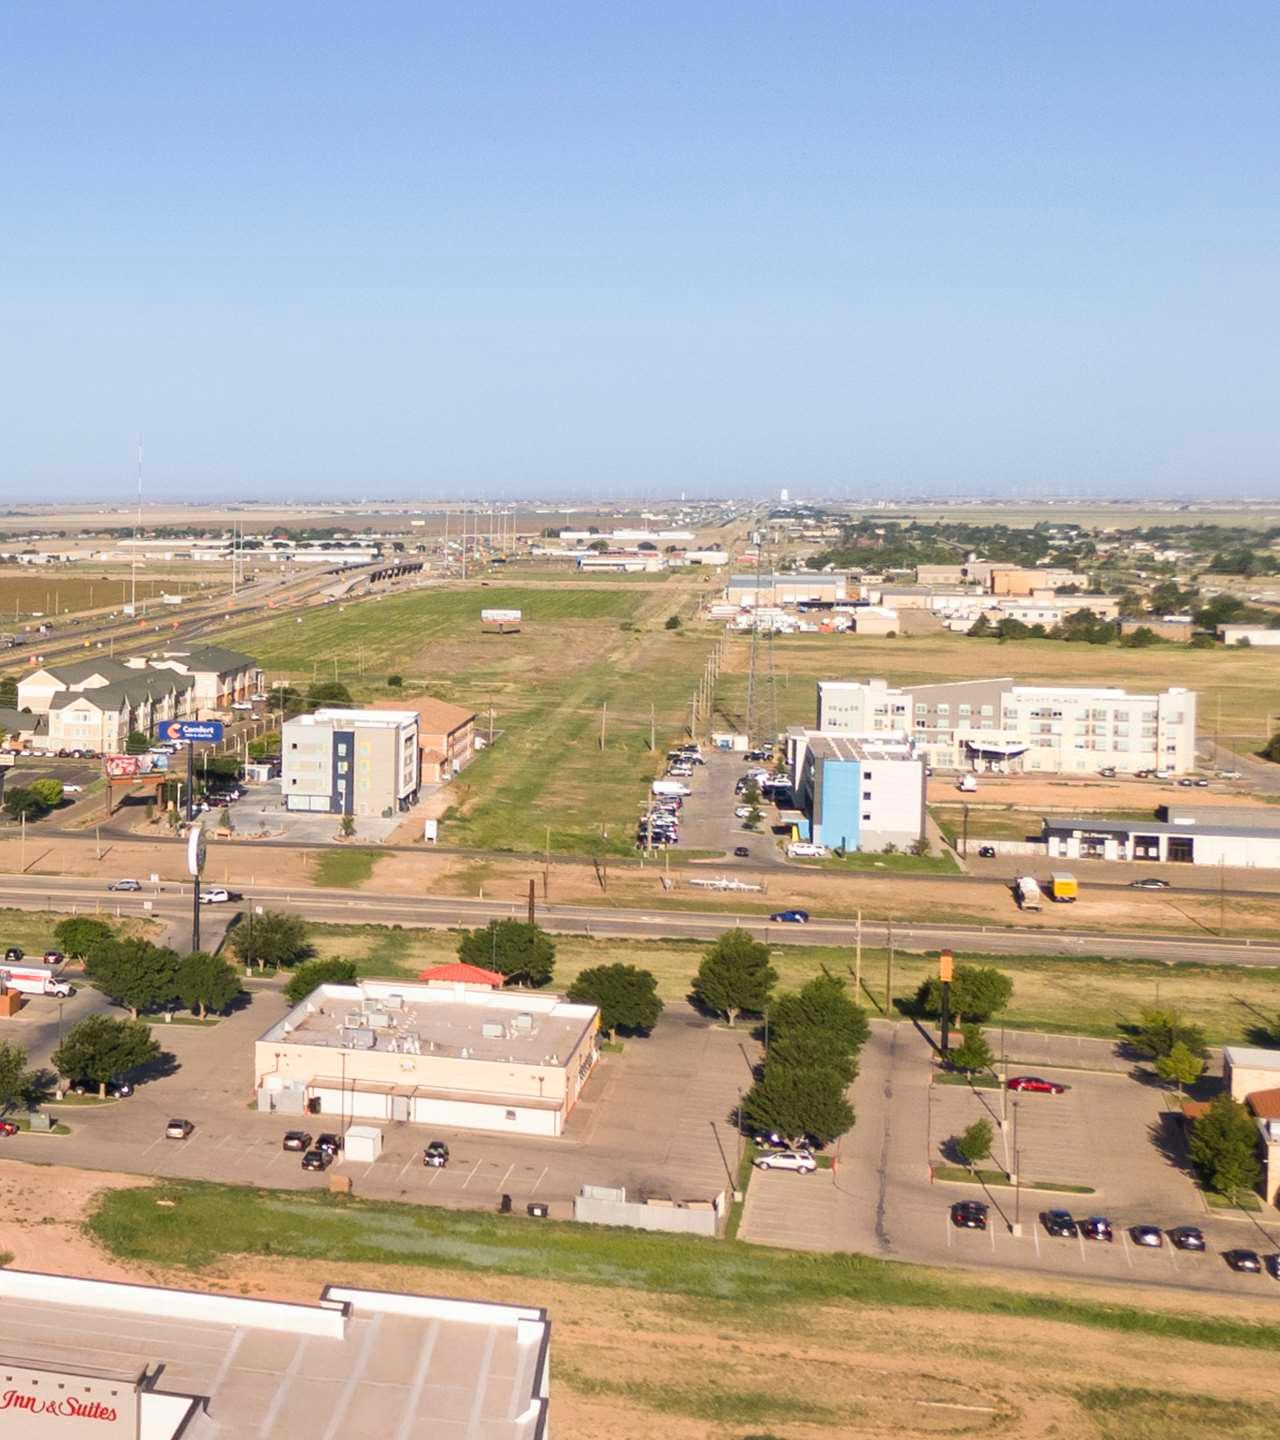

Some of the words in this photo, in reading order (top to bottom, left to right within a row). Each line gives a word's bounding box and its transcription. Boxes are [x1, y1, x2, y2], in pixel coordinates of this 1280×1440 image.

[182, 725, 215, 734] Comfort
[45, 1400, 60, 1417] &
[58, 1396, 118, 1422] Suites
